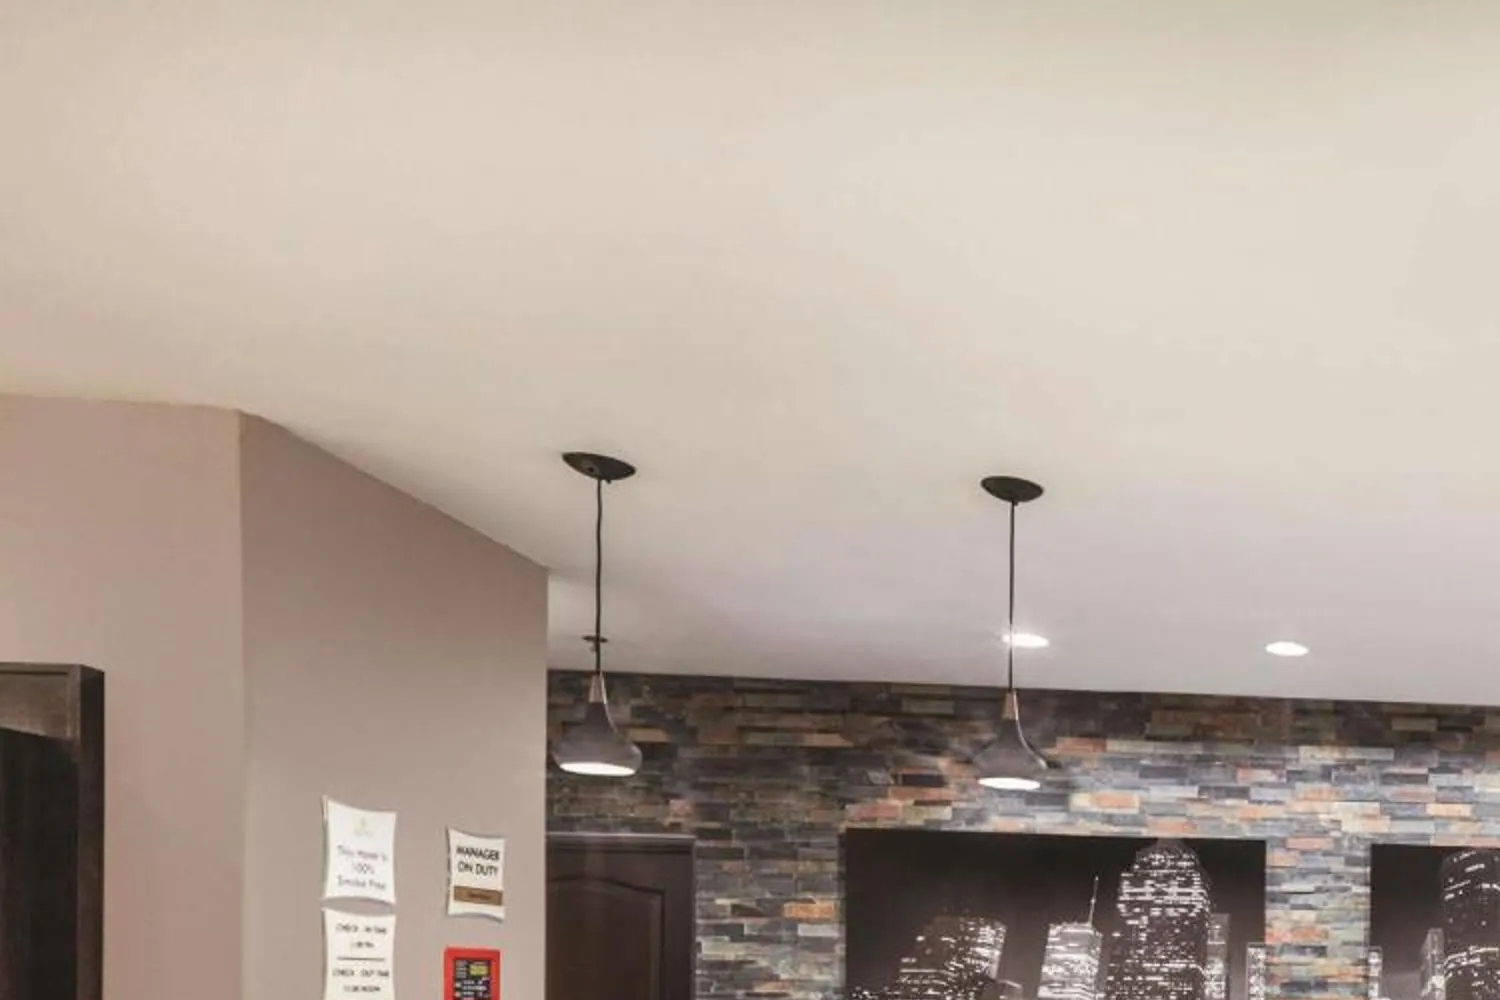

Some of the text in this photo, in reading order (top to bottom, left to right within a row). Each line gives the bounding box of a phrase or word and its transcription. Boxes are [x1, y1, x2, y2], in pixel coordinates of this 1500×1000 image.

[456, 846, 500, 861] MANAGER
[458, 861, 499, 876] ON DUTY
